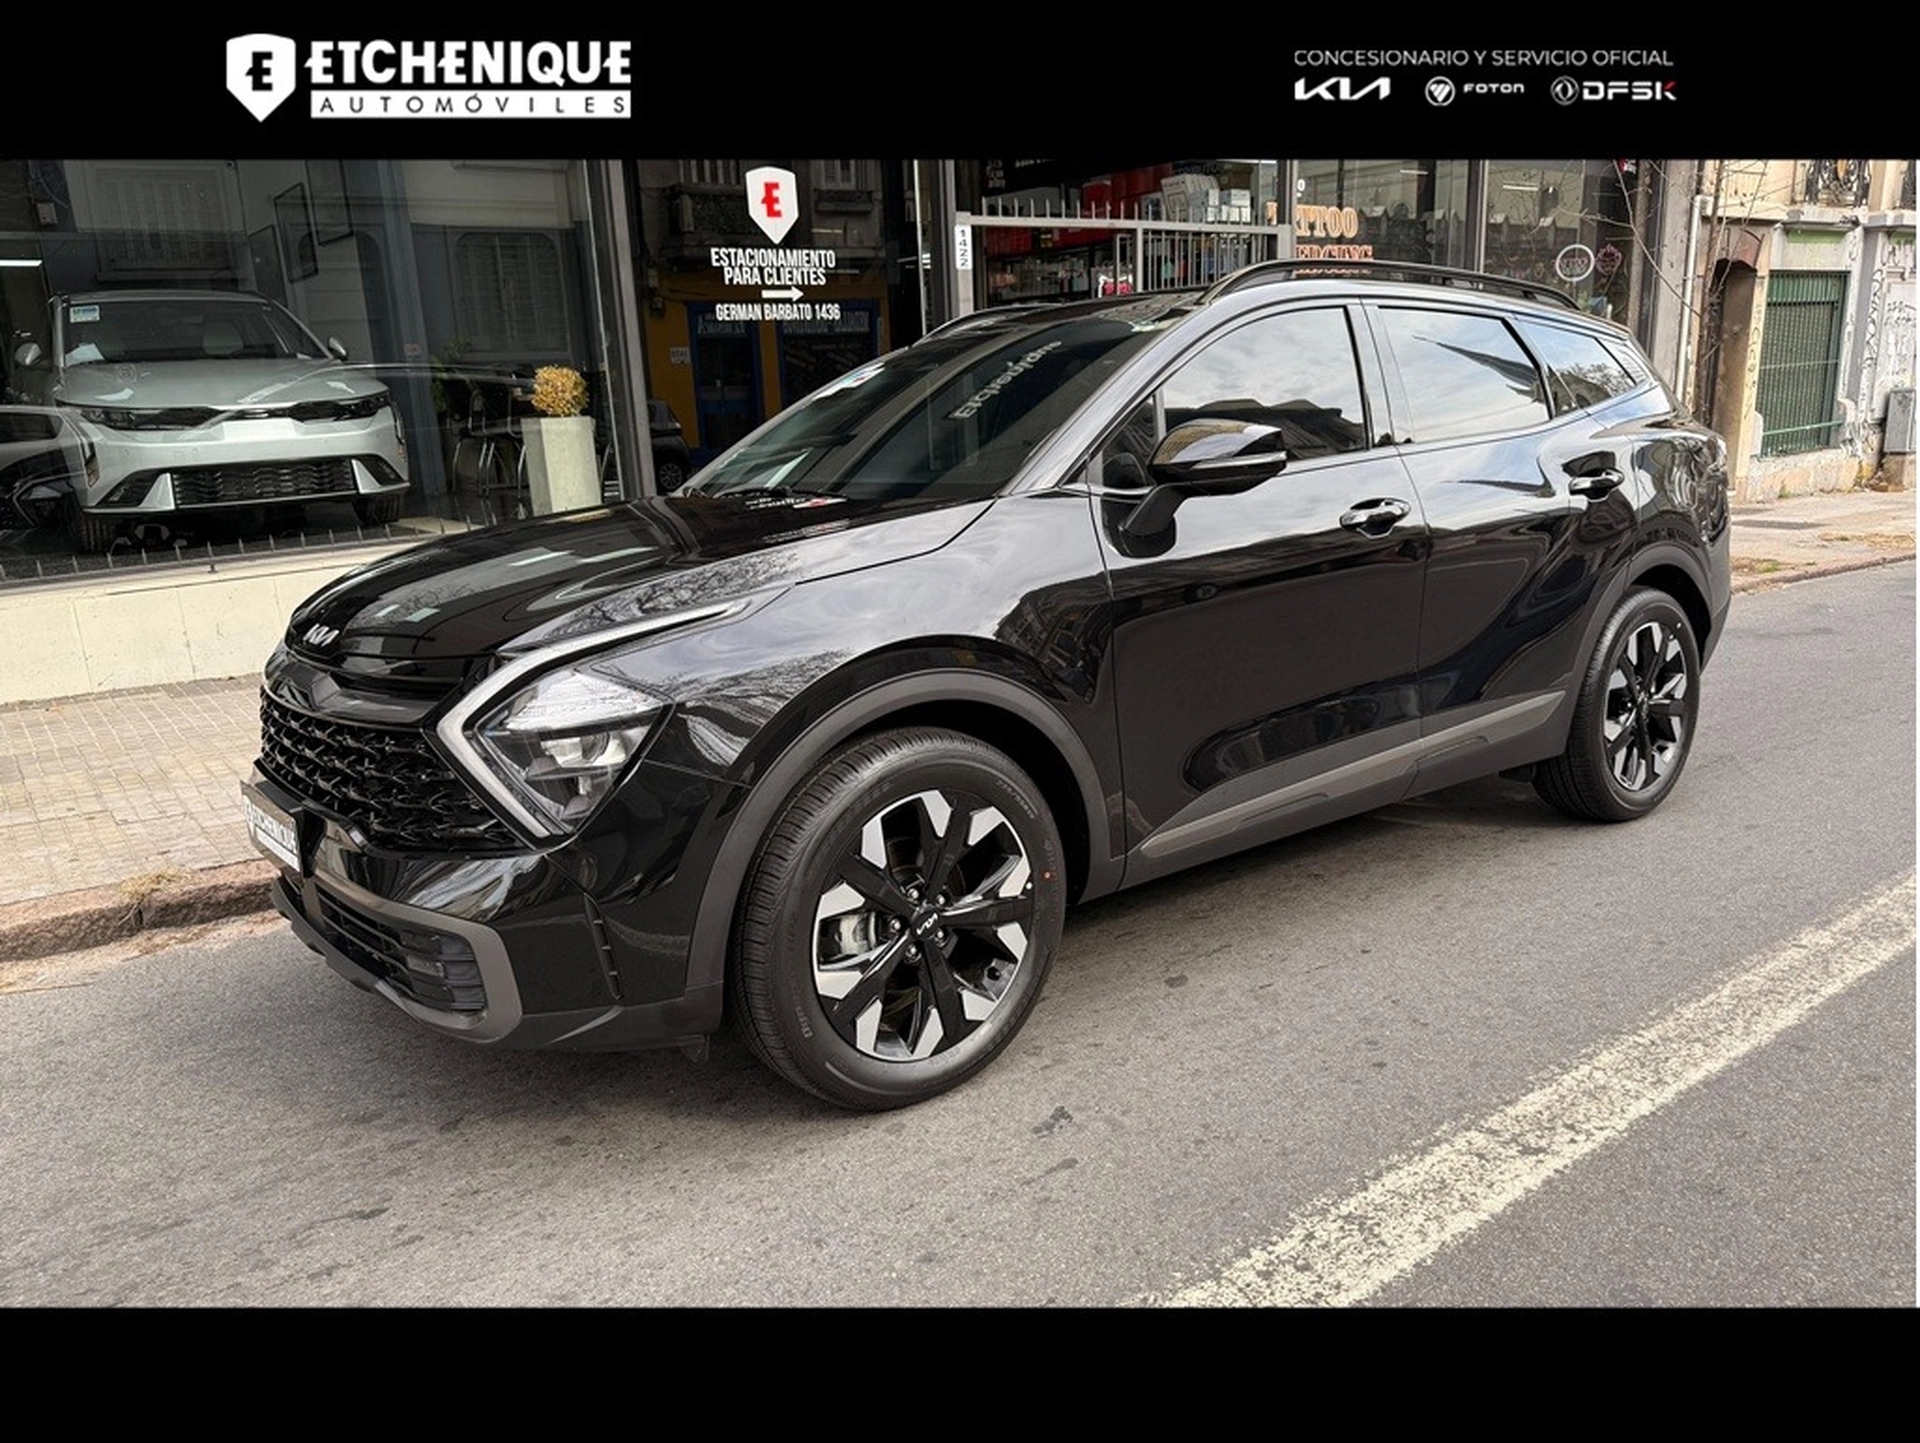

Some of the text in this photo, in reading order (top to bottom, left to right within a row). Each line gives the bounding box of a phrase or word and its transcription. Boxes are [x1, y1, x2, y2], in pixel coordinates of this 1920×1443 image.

[1266, 201, 1358, 239] TTTOO
[959, 229, 968, 266] 1422
[711, 248, 836, 268] ESTACIONAMIENTO
[724, 267, 826, 285] PARA CLIENTES
[716, 303, 840, 321] GERMAN BARBATO 1436
